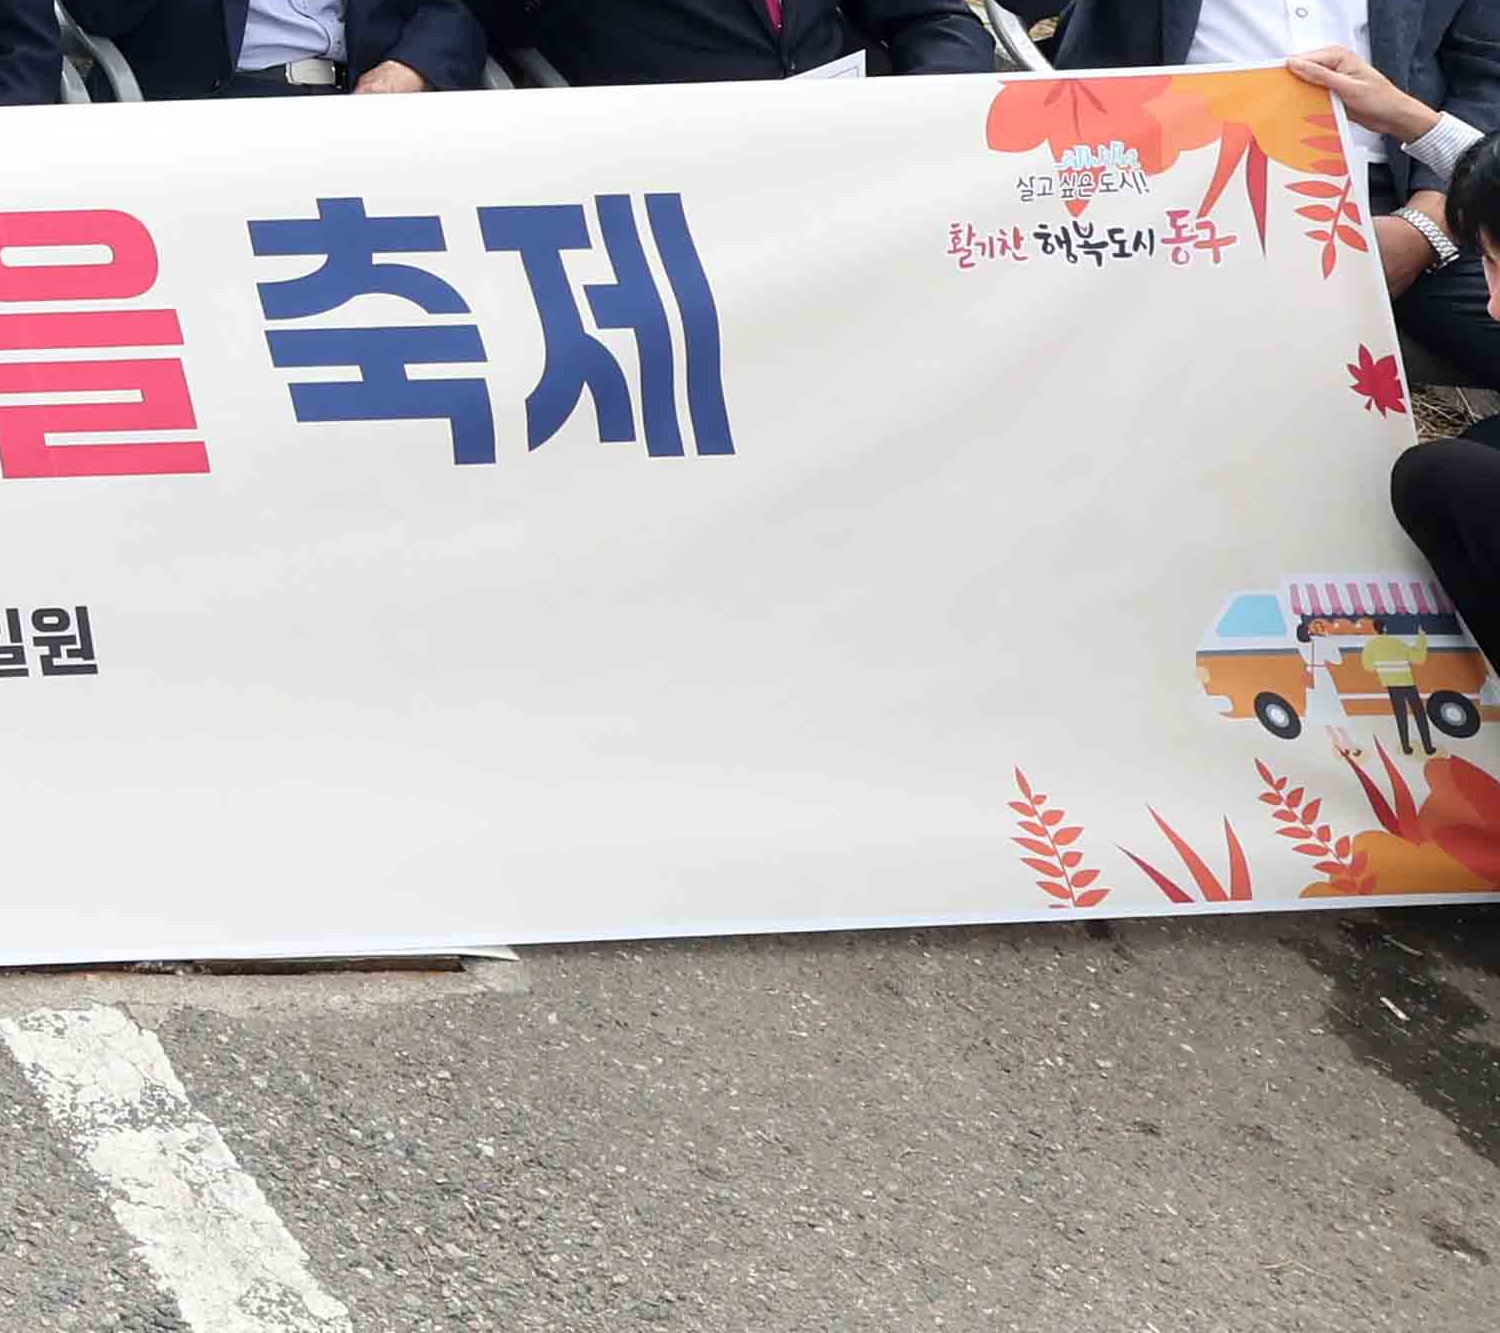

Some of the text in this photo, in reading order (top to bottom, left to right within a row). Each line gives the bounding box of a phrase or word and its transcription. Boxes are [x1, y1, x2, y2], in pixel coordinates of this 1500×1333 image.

[1015, 171, 1151, 202] 살고 싶은 도시!
[947, 209, 1238, 268] 활기찬 행복도시 동구
[253, 196, 734, 462] 축제
